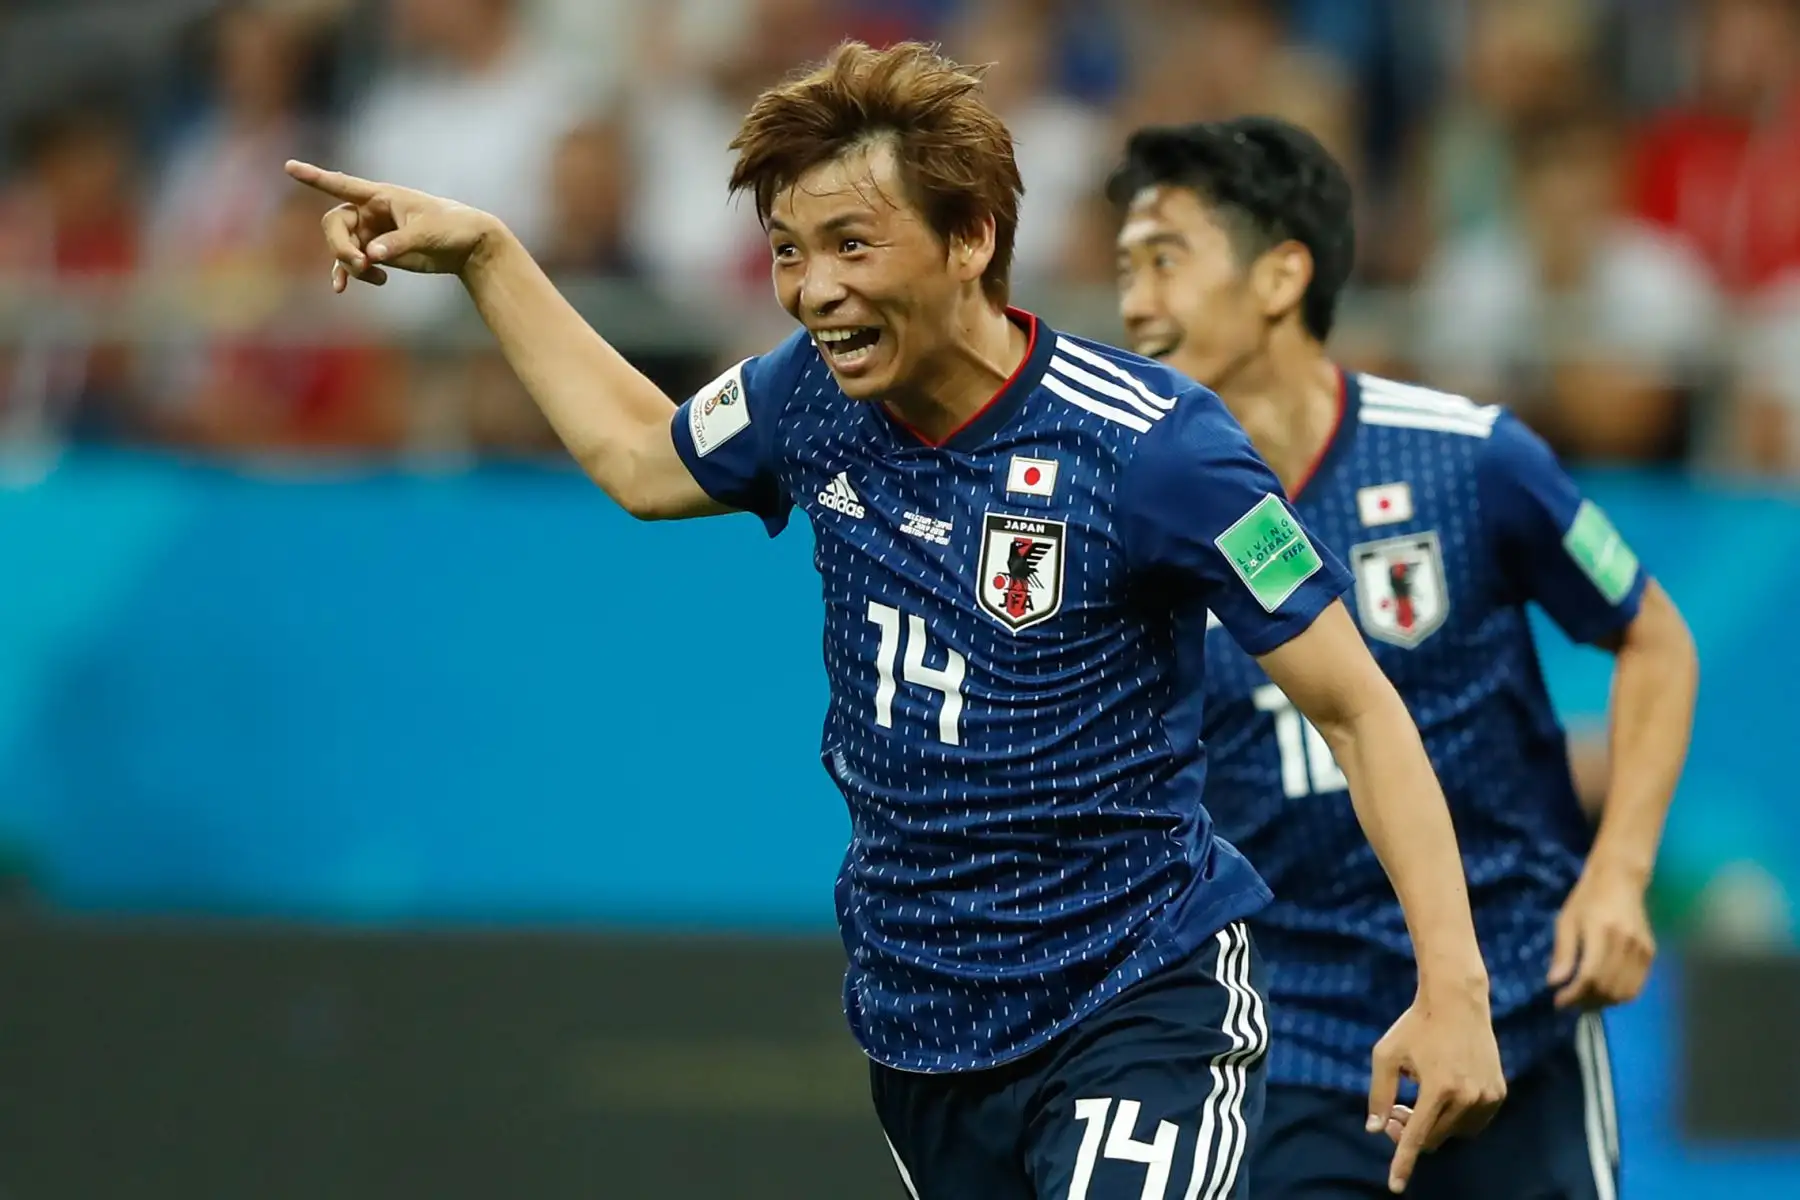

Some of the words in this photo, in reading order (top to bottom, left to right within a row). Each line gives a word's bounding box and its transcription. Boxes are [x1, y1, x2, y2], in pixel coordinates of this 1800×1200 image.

[818, 491, 866, 519] adidas
[1004, 520, 1046, 534] JAPAN
[1236, 518, 1289, 566] LIVING
[1281, 542, 1306, 563] FIFA
[997, 592, 1035, 612] JFA
[867, 600, 966, 746] 14
[1066, 1097, 1180, 1200] 14
